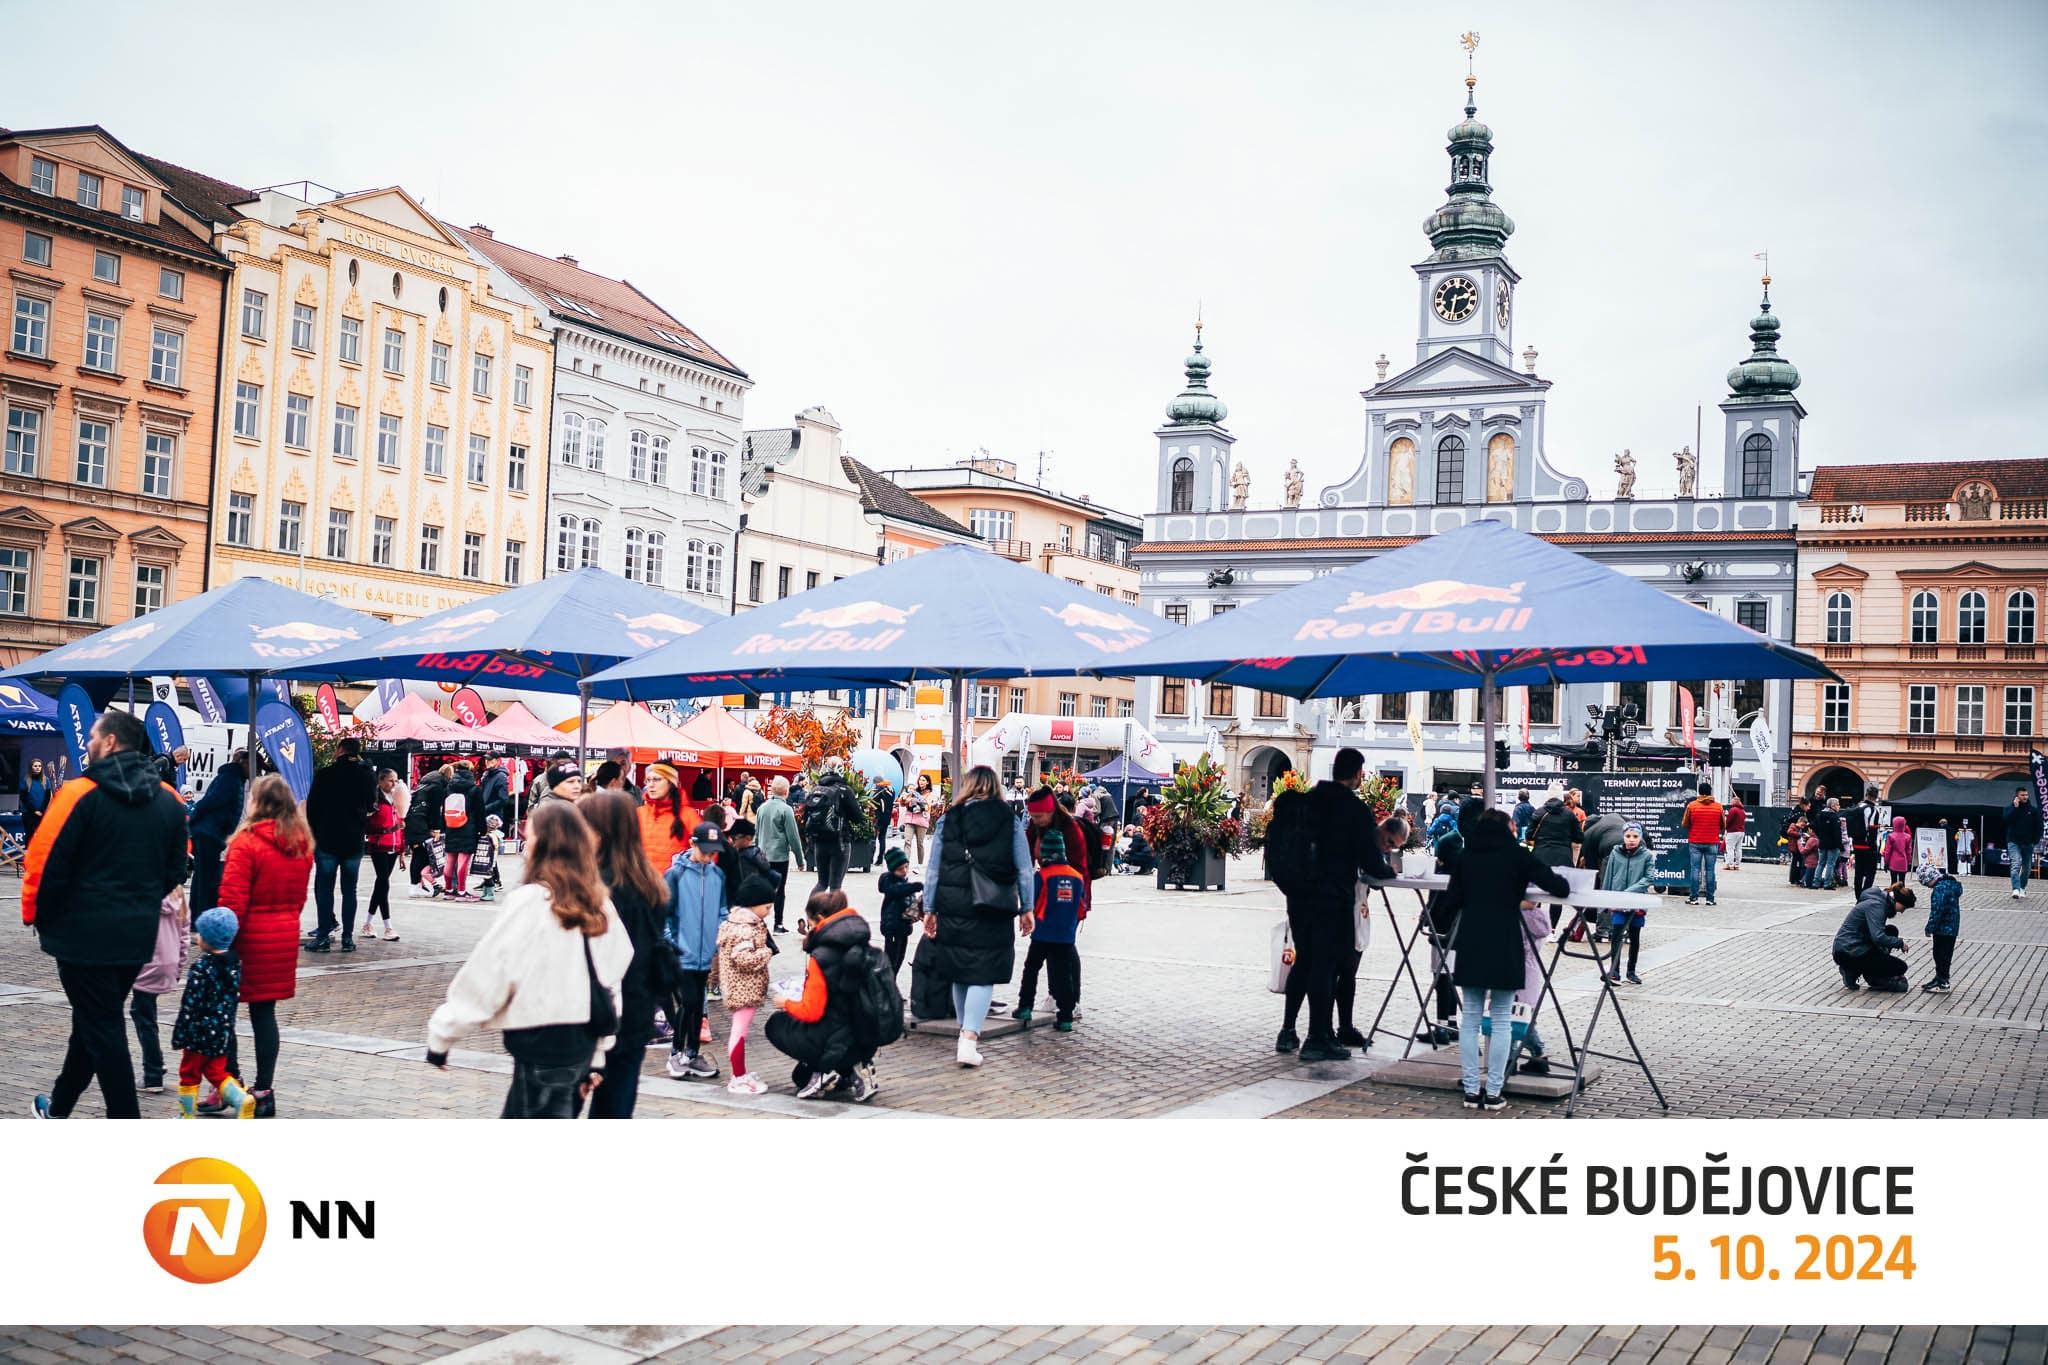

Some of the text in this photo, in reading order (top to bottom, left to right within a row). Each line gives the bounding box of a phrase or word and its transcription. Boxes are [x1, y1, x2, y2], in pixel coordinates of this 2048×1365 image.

[344, 226, 391, 253] HOTEL
[365, 587, 429, 608] GALERIE
[1295, 607, 1533, 640] Red Bull
[732, 629, 906, 655] Red Bull
[8, 720, 56, 731] VARTA
[744, 755, 782, 766] NUTREND
[1502, 777, 1546, 786] PROPOZICE
[1603, 778, 1683, 788] TERMÍNY AKCÍ 2024
